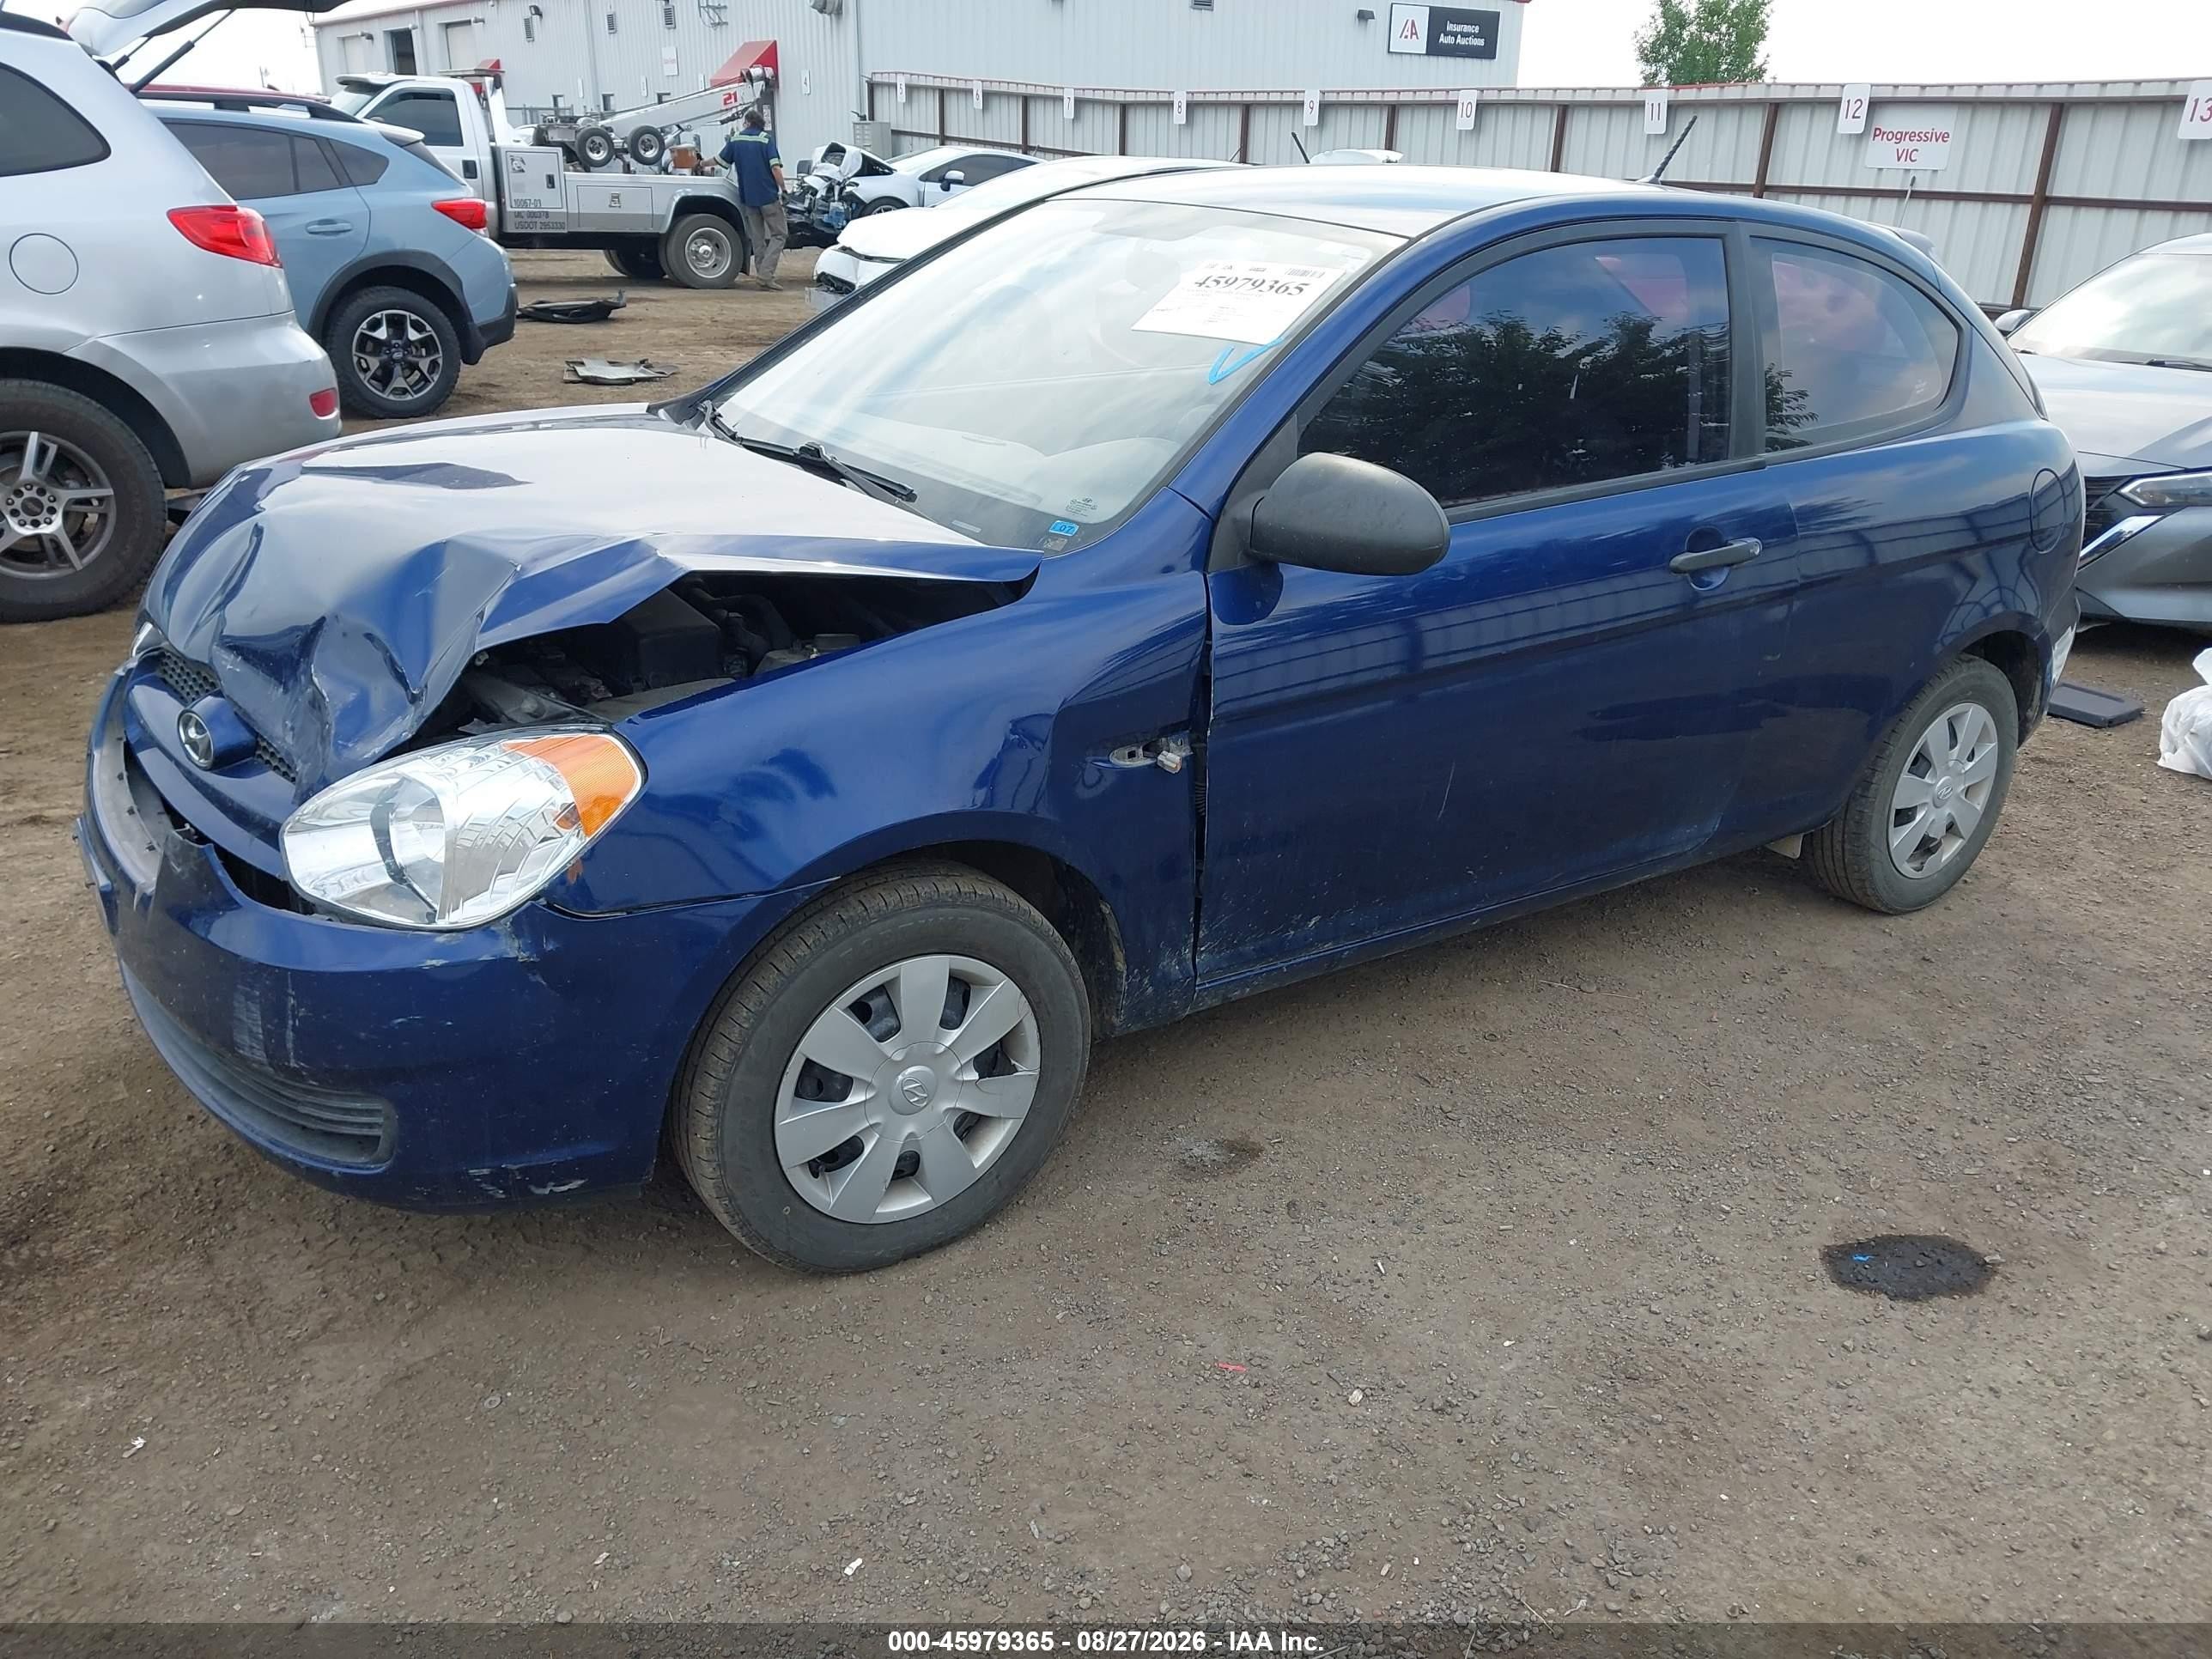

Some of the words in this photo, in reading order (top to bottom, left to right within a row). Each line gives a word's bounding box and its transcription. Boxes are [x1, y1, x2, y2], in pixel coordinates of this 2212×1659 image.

[1446, 20, 1480, 33] Insurance
[1438, 33, 1455, 45] Auto
[1455, 33, 1486, 46] Auctions
[803, 76, 809, 88] 4
[898, 84, 903, 95] 5
[723, 90, 738, 106] 21
[975, 90, 980, 101] 6
[1066, 96, 1072, 111] 7
[1177, 100, 1183, 115] 8
[1309, 100, 1315, 115] 9
[1460, 100, 1473, 118] 10
[1845, 99, 1863, 119] 12
[2190, 97, 2212, 122] 13
[1648, 101, 1662, 122] 11
[1872, 127, 1950, 144] Progressive
[1896, 148, 1918, 162] VIC
[1194, 275, 1311, 296] 45979365
